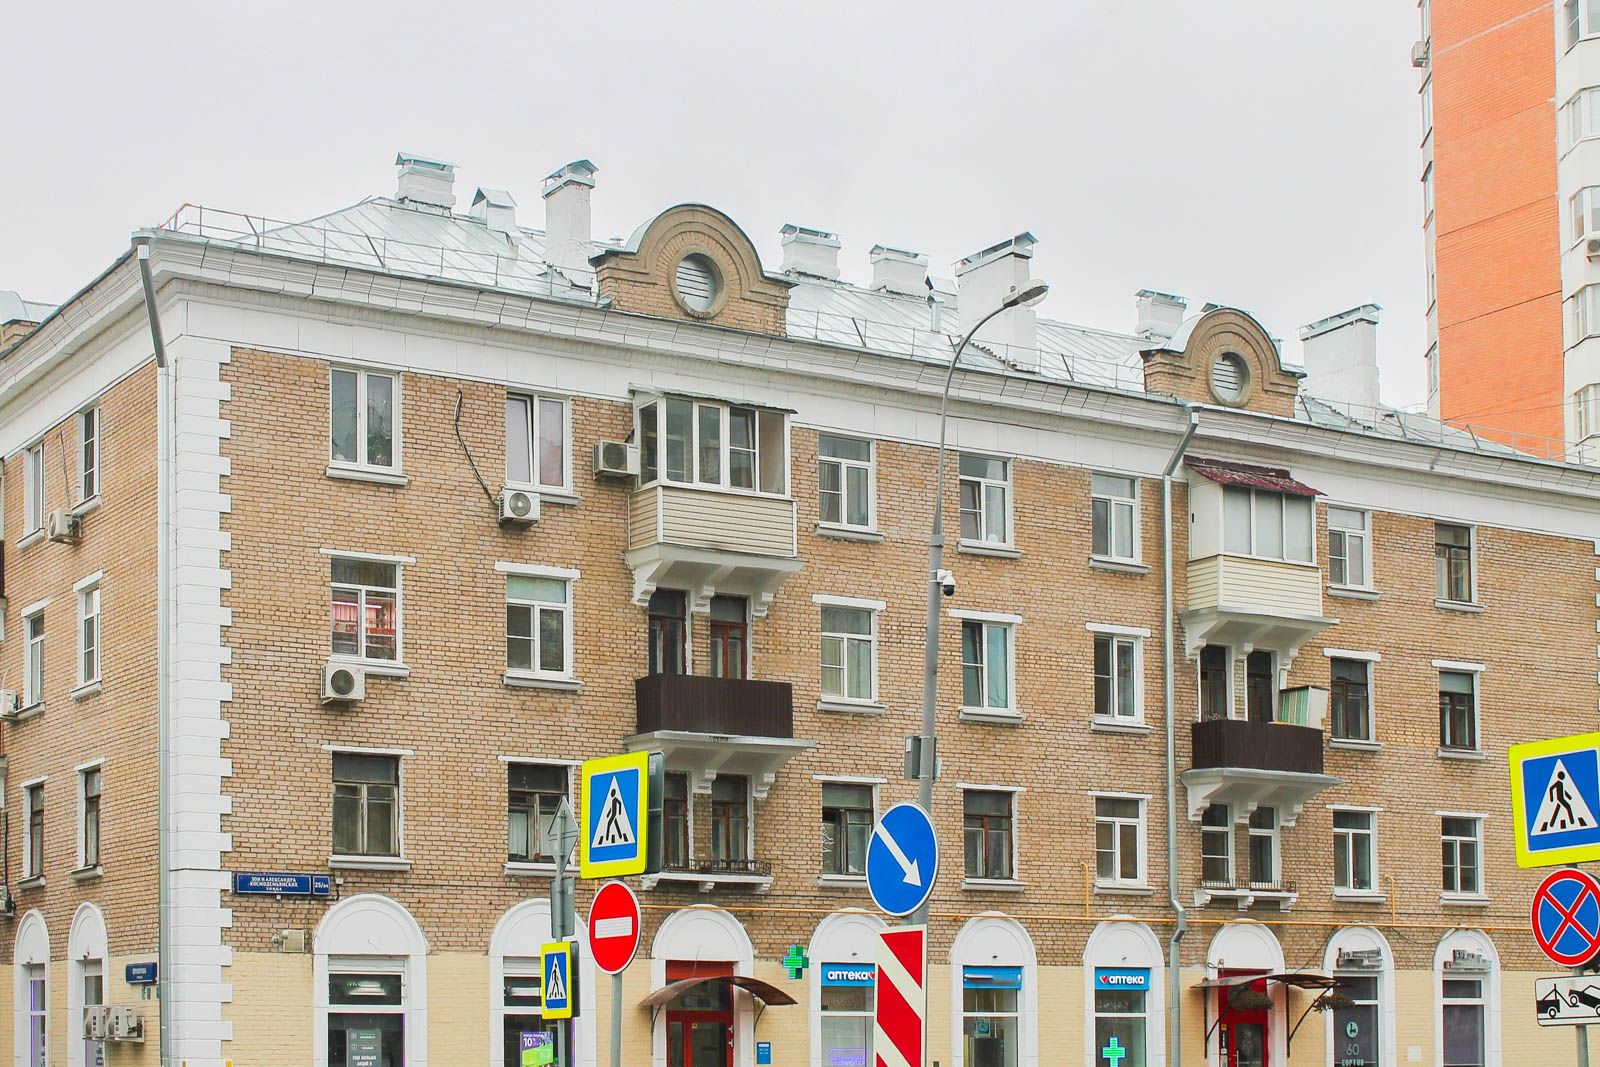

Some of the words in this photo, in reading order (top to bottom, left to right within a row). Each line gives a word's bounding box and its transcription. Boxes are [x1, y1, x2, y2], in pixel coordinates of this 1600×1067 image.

[828, 970, 868, 980] аптека
[1109, 975, 1145, 984] аптека
[1346, 1043, 1359, 1056] 60
[1341, 1058, 1364, 1066] СОРТОВ
